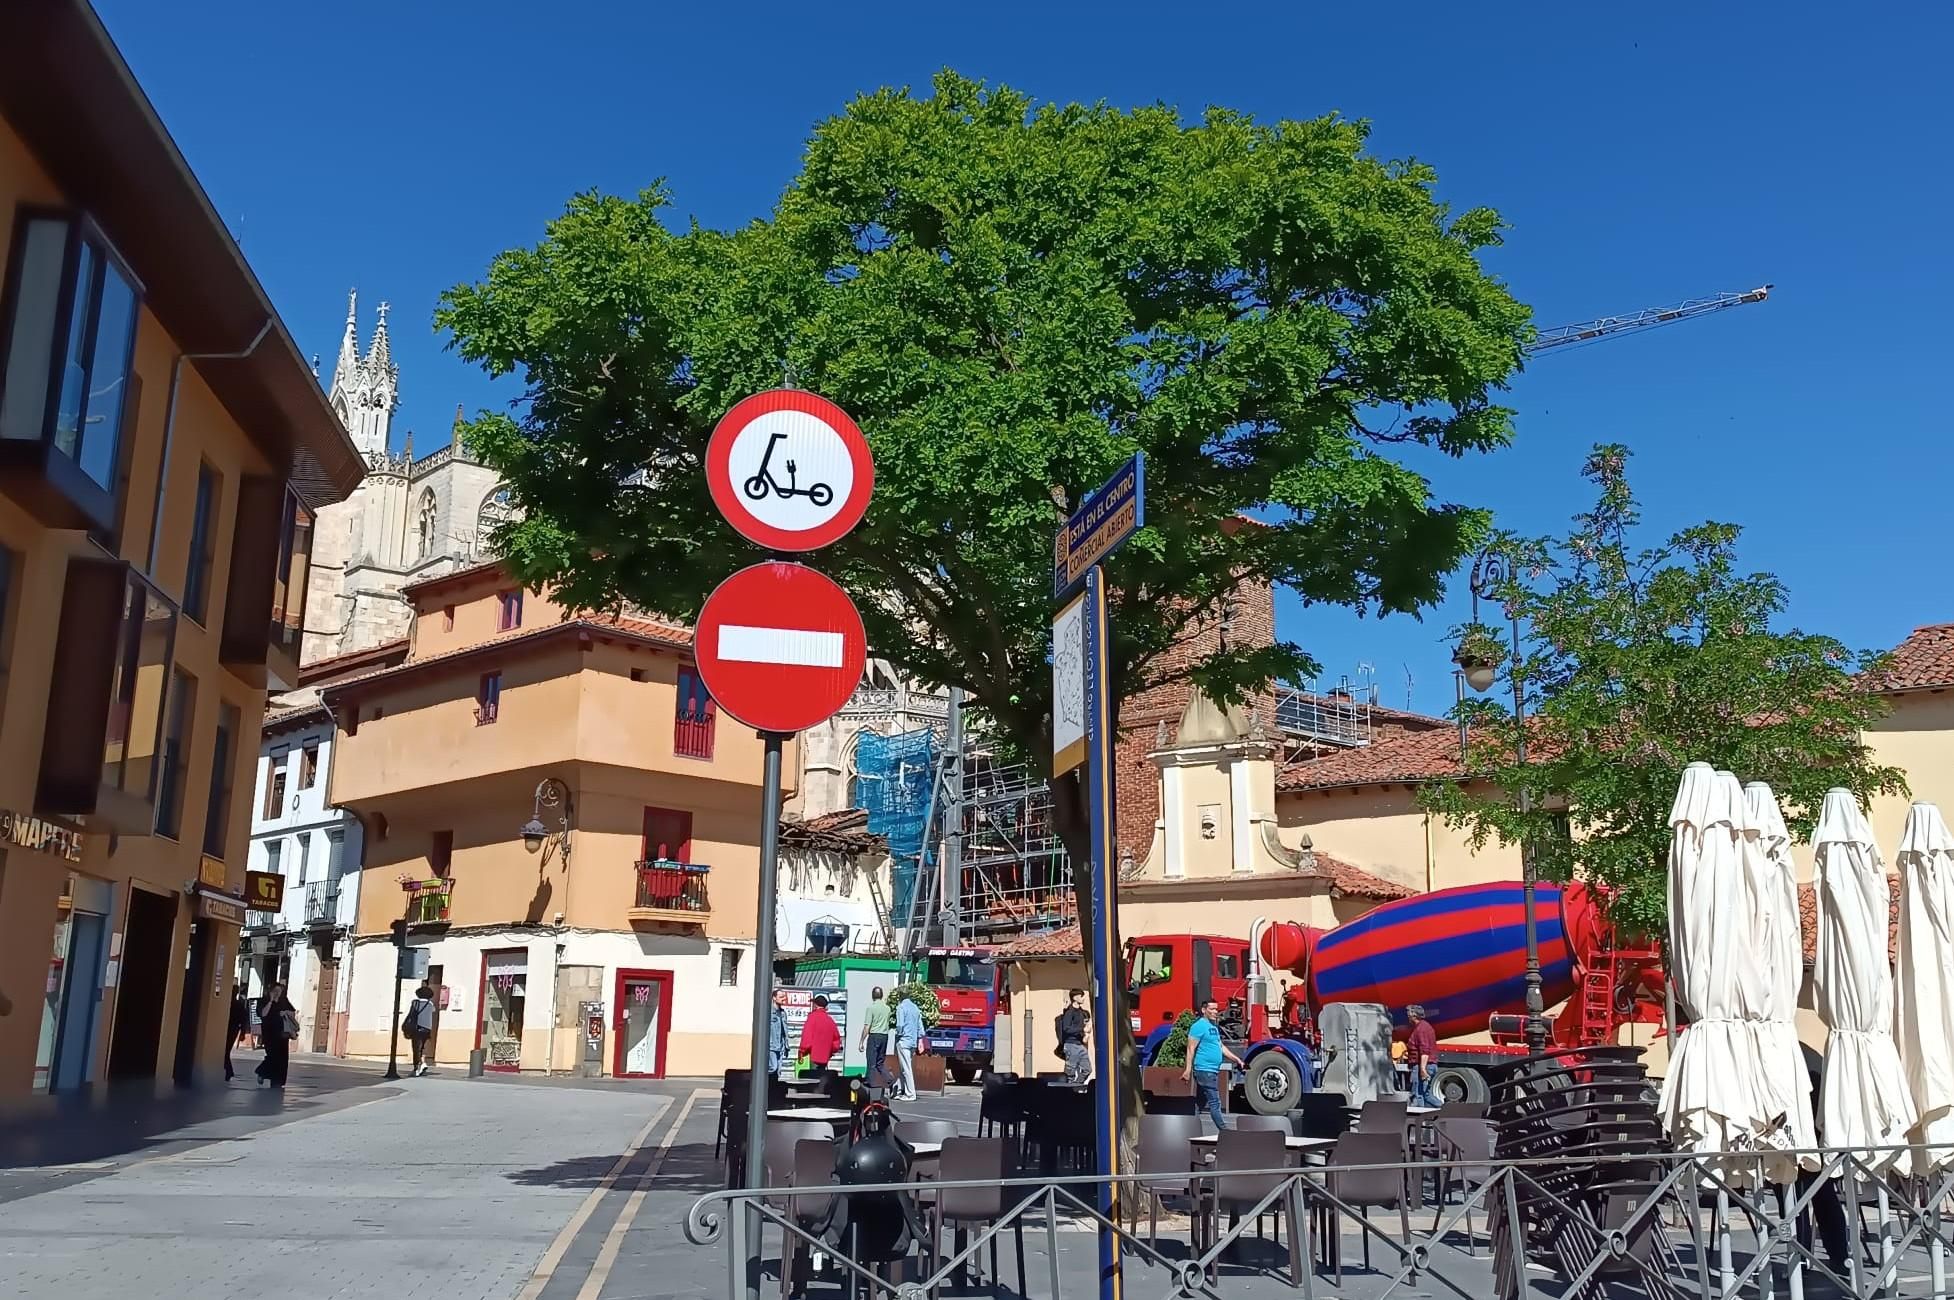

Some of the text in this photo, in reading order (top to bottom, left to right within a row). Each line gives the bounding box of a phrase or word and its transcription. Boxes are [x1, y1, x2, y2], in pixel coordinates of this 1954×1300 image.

[1070, 471, 1135, 545] ESTÁ EN EL CENTRO
[1069, 504, 1134, 575] COMERCIAL ABIERTO
[12, 813, 82, 864] MAPFRE
[252, 899, 279, 907] TABACOS
[787, 992, 811, 1006] VENDE
